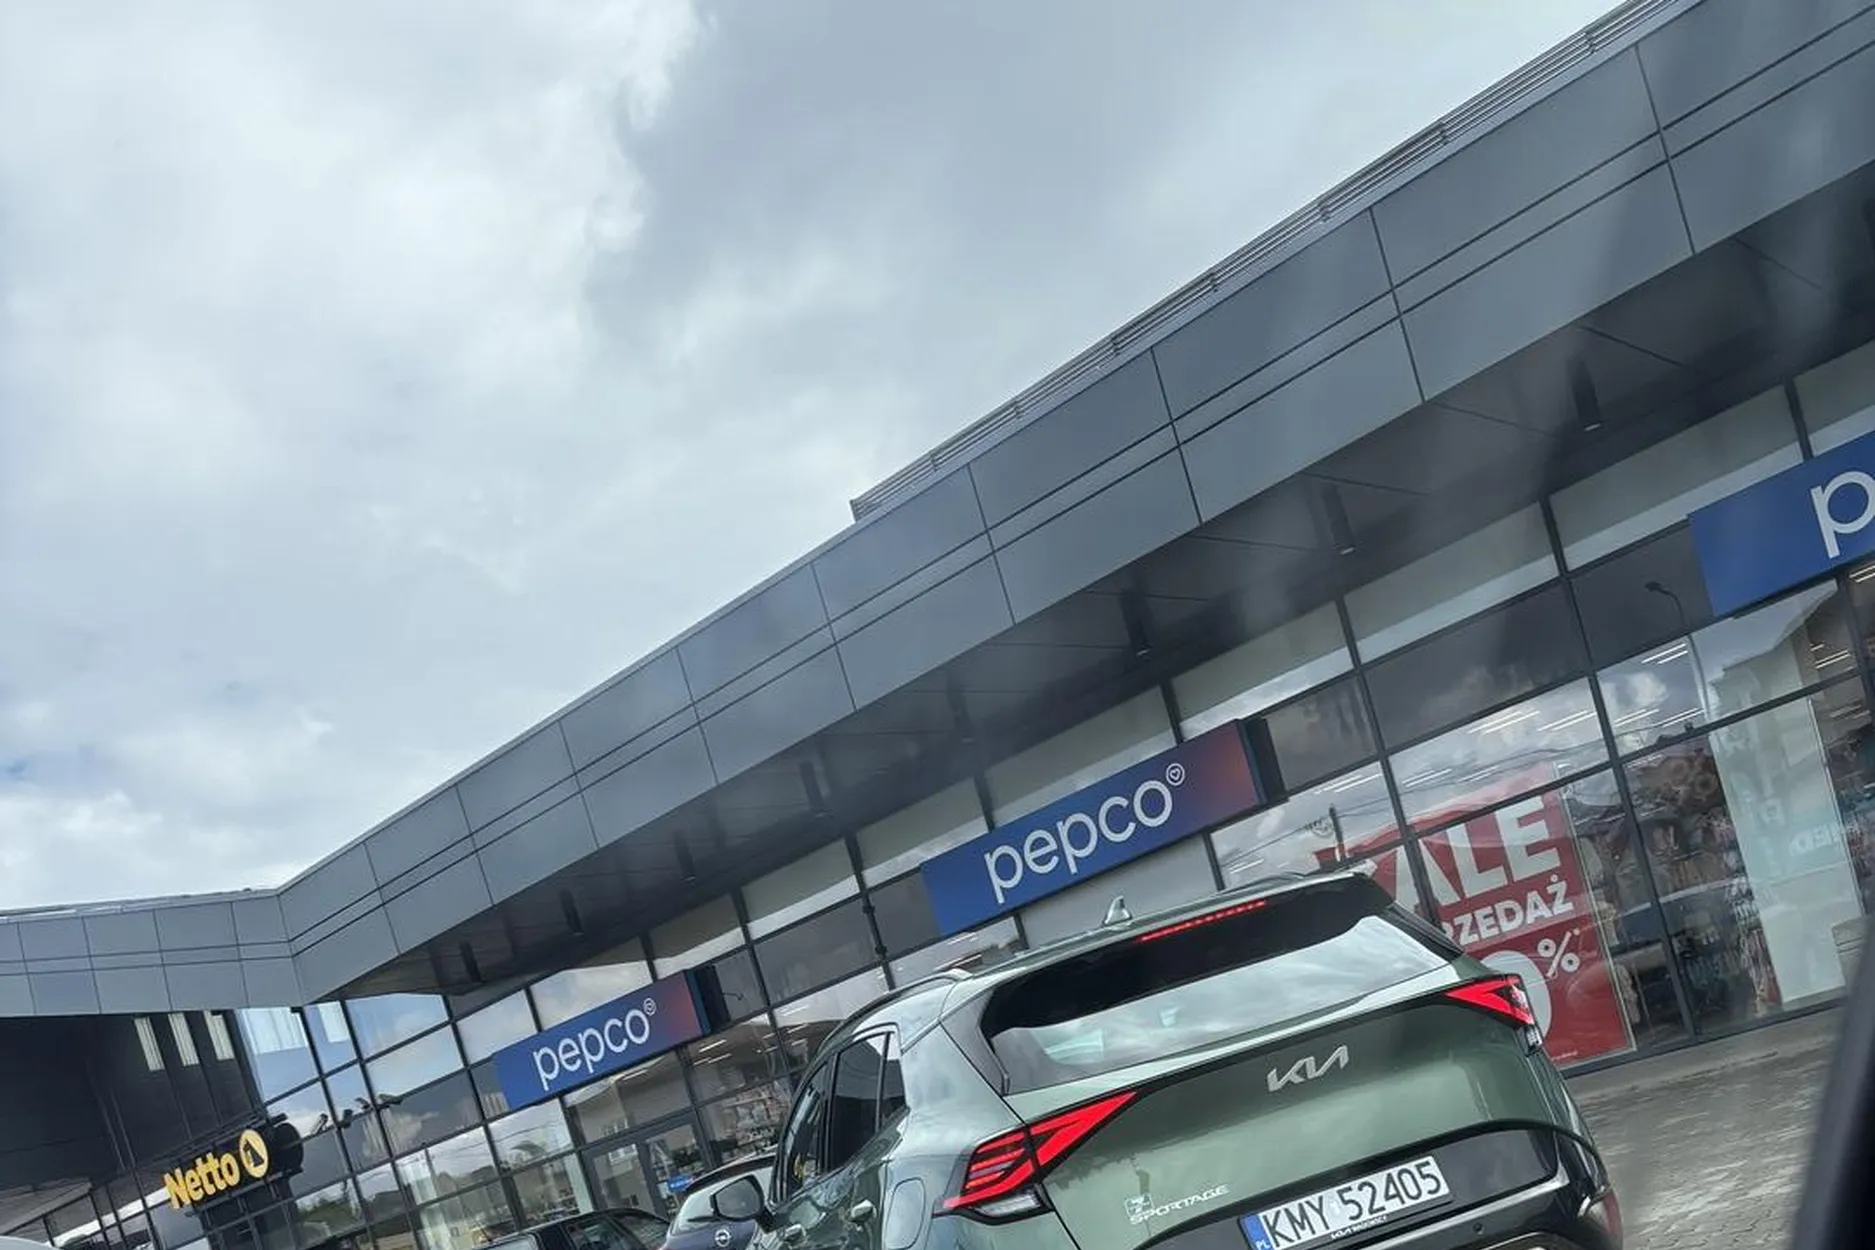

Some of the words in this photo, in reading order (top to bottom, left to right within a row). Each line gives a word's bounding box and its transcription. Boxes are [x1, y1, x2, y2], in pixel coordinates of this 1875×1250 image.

[984, 780, 1173, 904] pepco
[1362, 795, 1562, 914] ALE
[533, 1009, 650, 1091] pepco
[163, 1152, 241, 1210] Netto
[1130, 1184, 1230, 1225] SPORTAGE
[1262, 1196, 1330, 1248] KMY
[1336, 1161, 1441, 1222] 52405
[1256, 1240, 1271, 1250] PL
